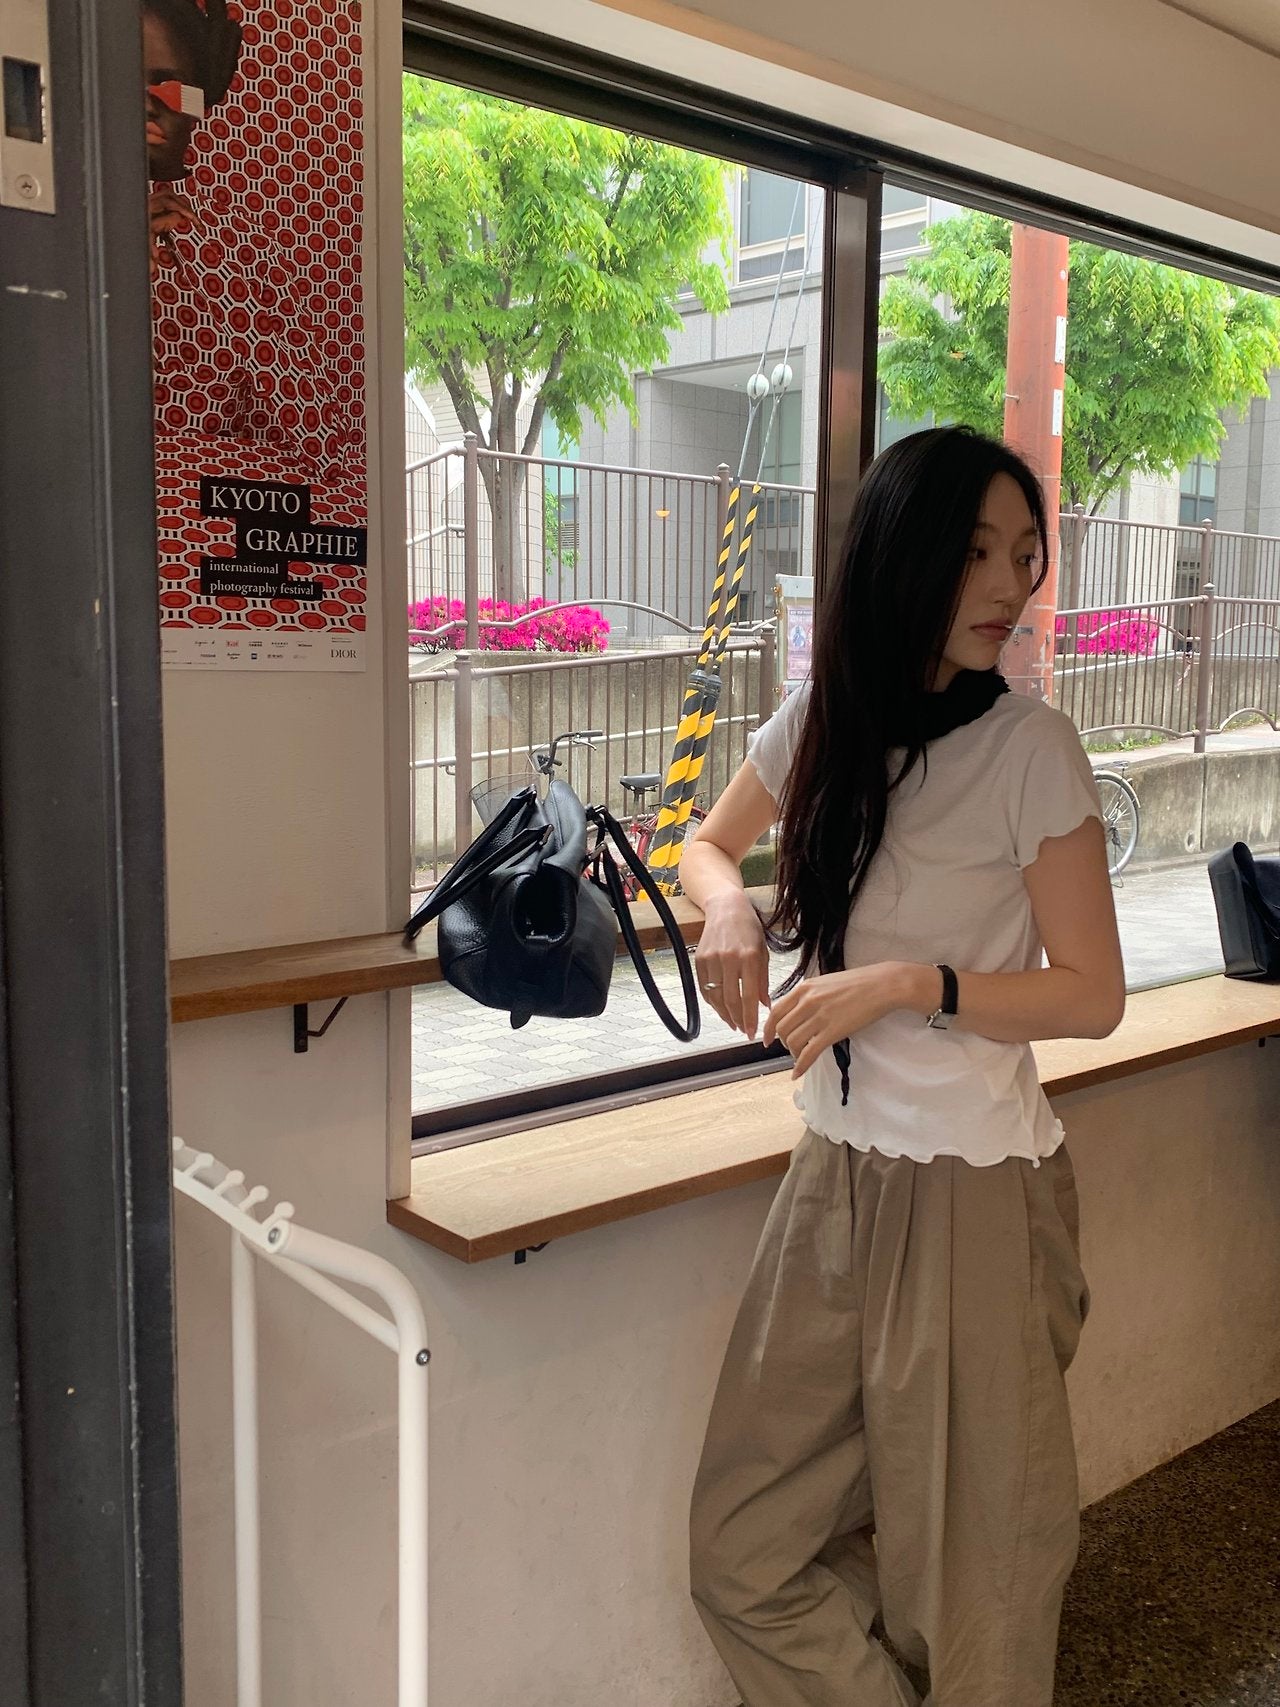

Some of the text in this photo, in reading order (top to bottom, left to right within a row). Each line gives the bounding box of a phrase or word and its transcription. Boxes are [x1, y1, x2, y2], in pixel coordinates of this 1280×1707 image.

[210, 485, 301, 515] KYOTO
[245, 528, 359, 557] GRAPHIE
[209, 560, 279, 575] international
[210, 580, 314, 597] photography festival
[330, 649, 357, 659] DIOR
